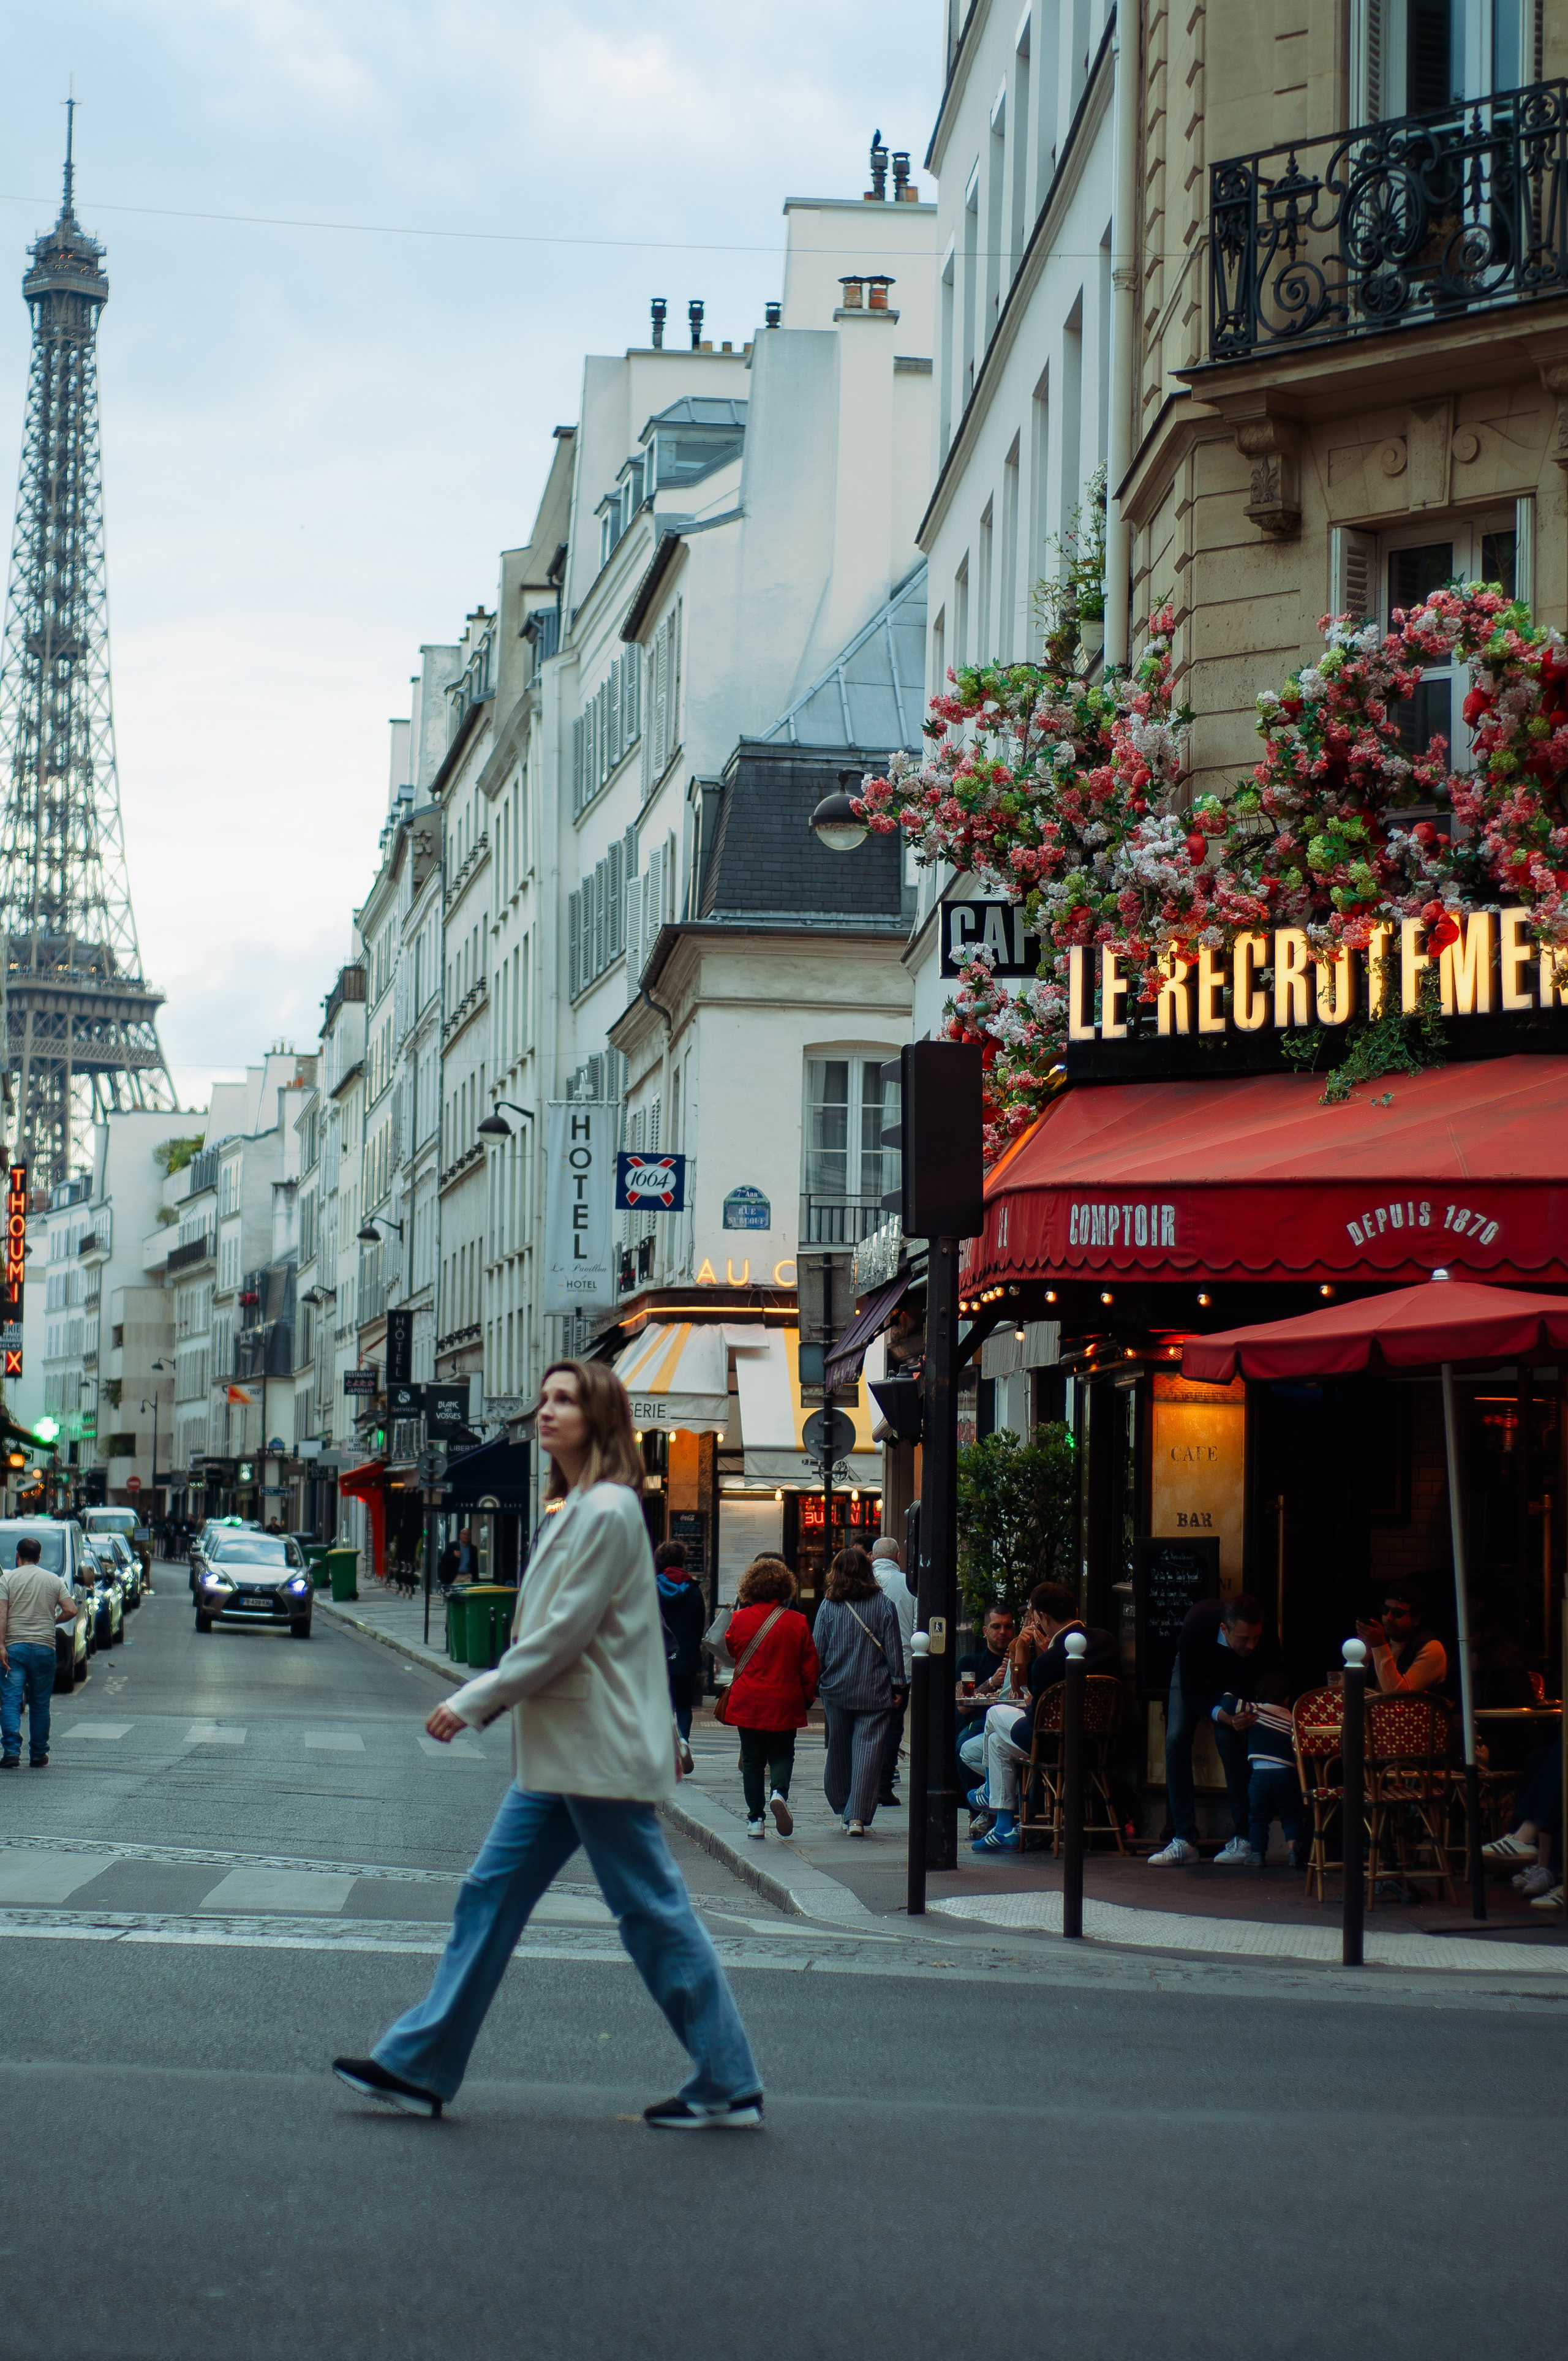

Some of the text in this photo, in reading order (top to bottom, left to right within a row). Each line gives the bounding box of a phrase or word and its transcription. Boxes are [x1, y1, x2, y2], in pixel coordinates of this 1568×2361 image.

[951, 906, 1035, 965] CAF
[1069, 943, 1127, 1041] LE
[569, 1115, 592, 1259] HOTEL
[630, 1169, 671, 1189] 1664
[1069, 1204, 1175, 1246] COMPTOIR
[1346, 1202, 1499, 1246] DEPUIS 1870
[566, 1280, 597, 1289] HOTEL
[696, 1257, 796, 1287] AU C
[438, 1401, 459, 1409] BLANC
[1177, 1512, 1213, 1527] BAR
